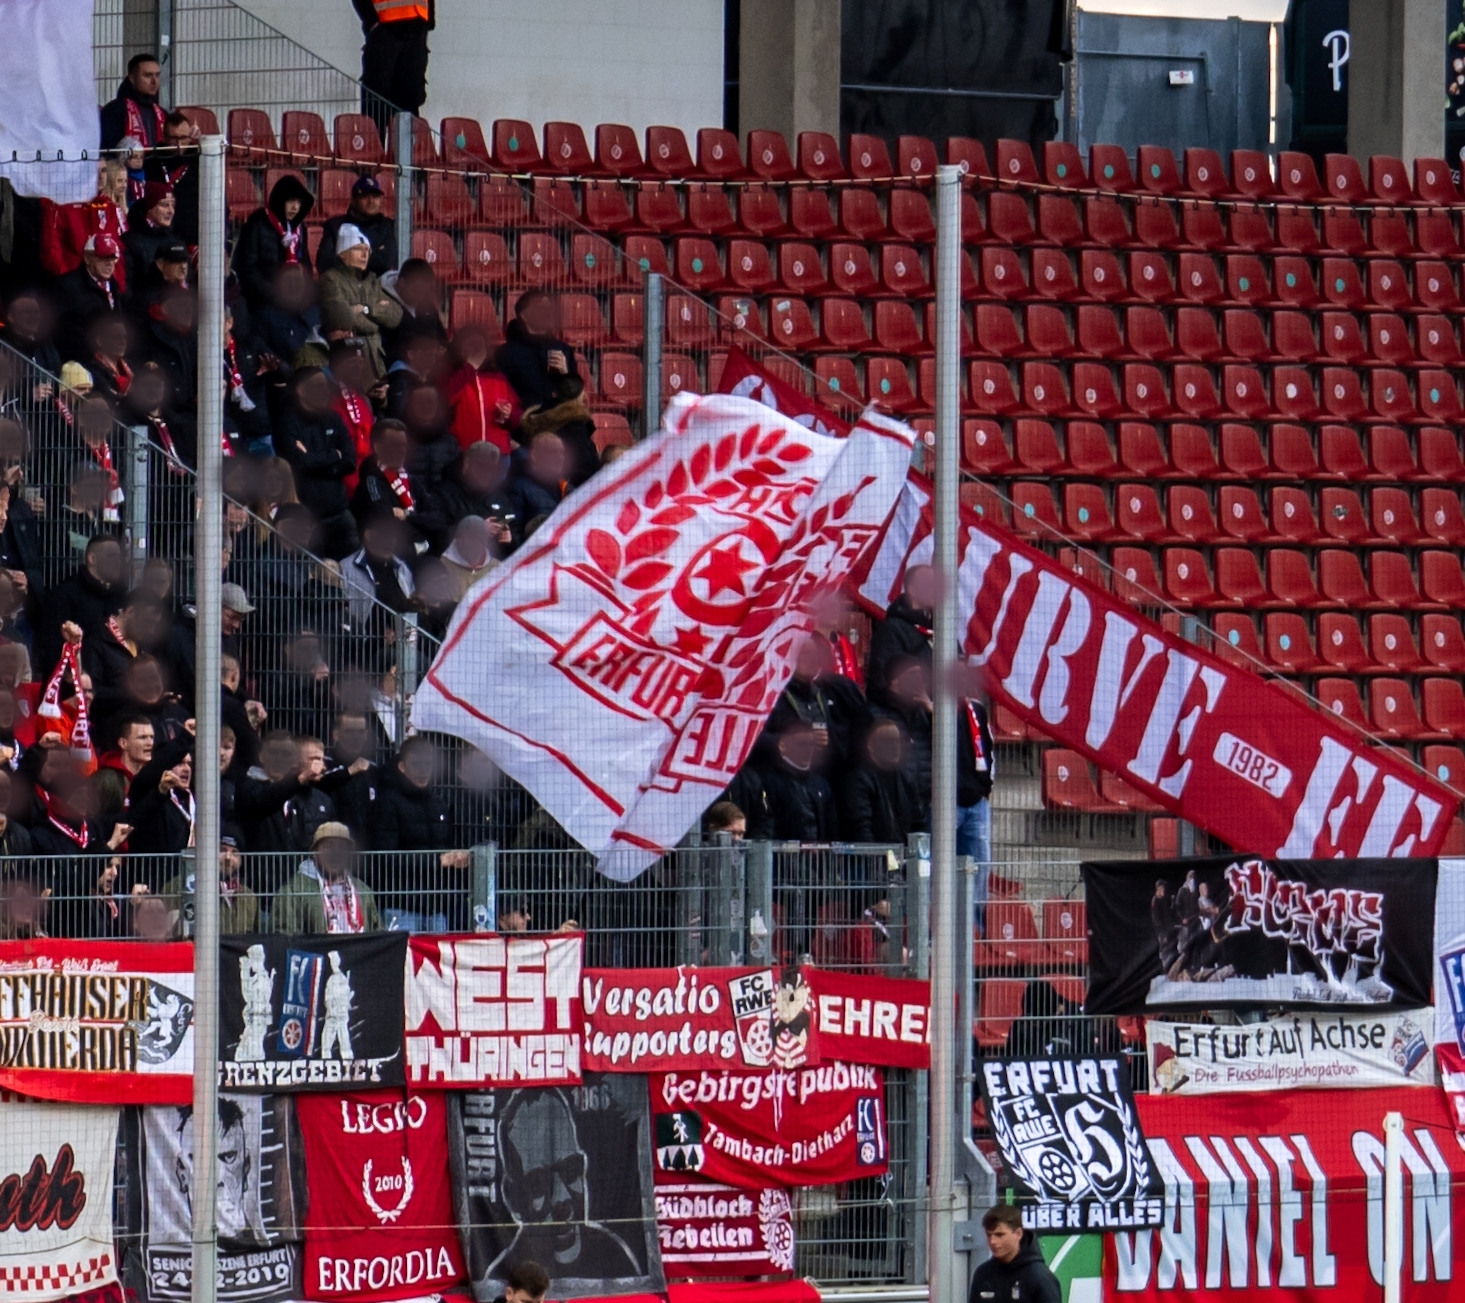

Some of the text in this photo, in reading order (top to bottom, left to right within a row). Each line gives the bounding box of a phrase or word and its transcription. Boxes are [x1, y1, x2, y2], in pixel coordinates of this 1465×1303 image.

[572, 633, 708, 722] ERFUR
[1224, 740, 1280, 791] 1982
[406, 938, 579, 1033] WEST
[584, 973, 721, 1021] Versatio
[734, 989, 773, 1016] RWE
[738, 975, 765, 997] FC
[406, 1030, 580, 1083] THÜRINGEN
[1173, 1017, 1386, 1062] Erfurt Auf Achse
[984, 1059, 1121, 1096] ERFURT
[1194, 1062, 1359, 1085] Die Fussballpsychopathen
[340, 1095, 428, 1134] LEGIO
[857, 1100, 874, 1130] FC
[1012, 1114, 1055, 1139] RWE
[1014, 1100, 1040, 1121] FC
[463, 1087, 497, 1203] RFURT
[703, 1113, 854, 1168] Tambach-Dietharz
[374, 1174, 403, 1193] 2010
[1021, 1198, 1163, 1231] ÜBER ALLES
[152, 1262, 290, 1290] 24-2-2010
[248, 1248, 288, 1268] ERFURT
[318, 1247, 456, 1292] ERFORDIA
